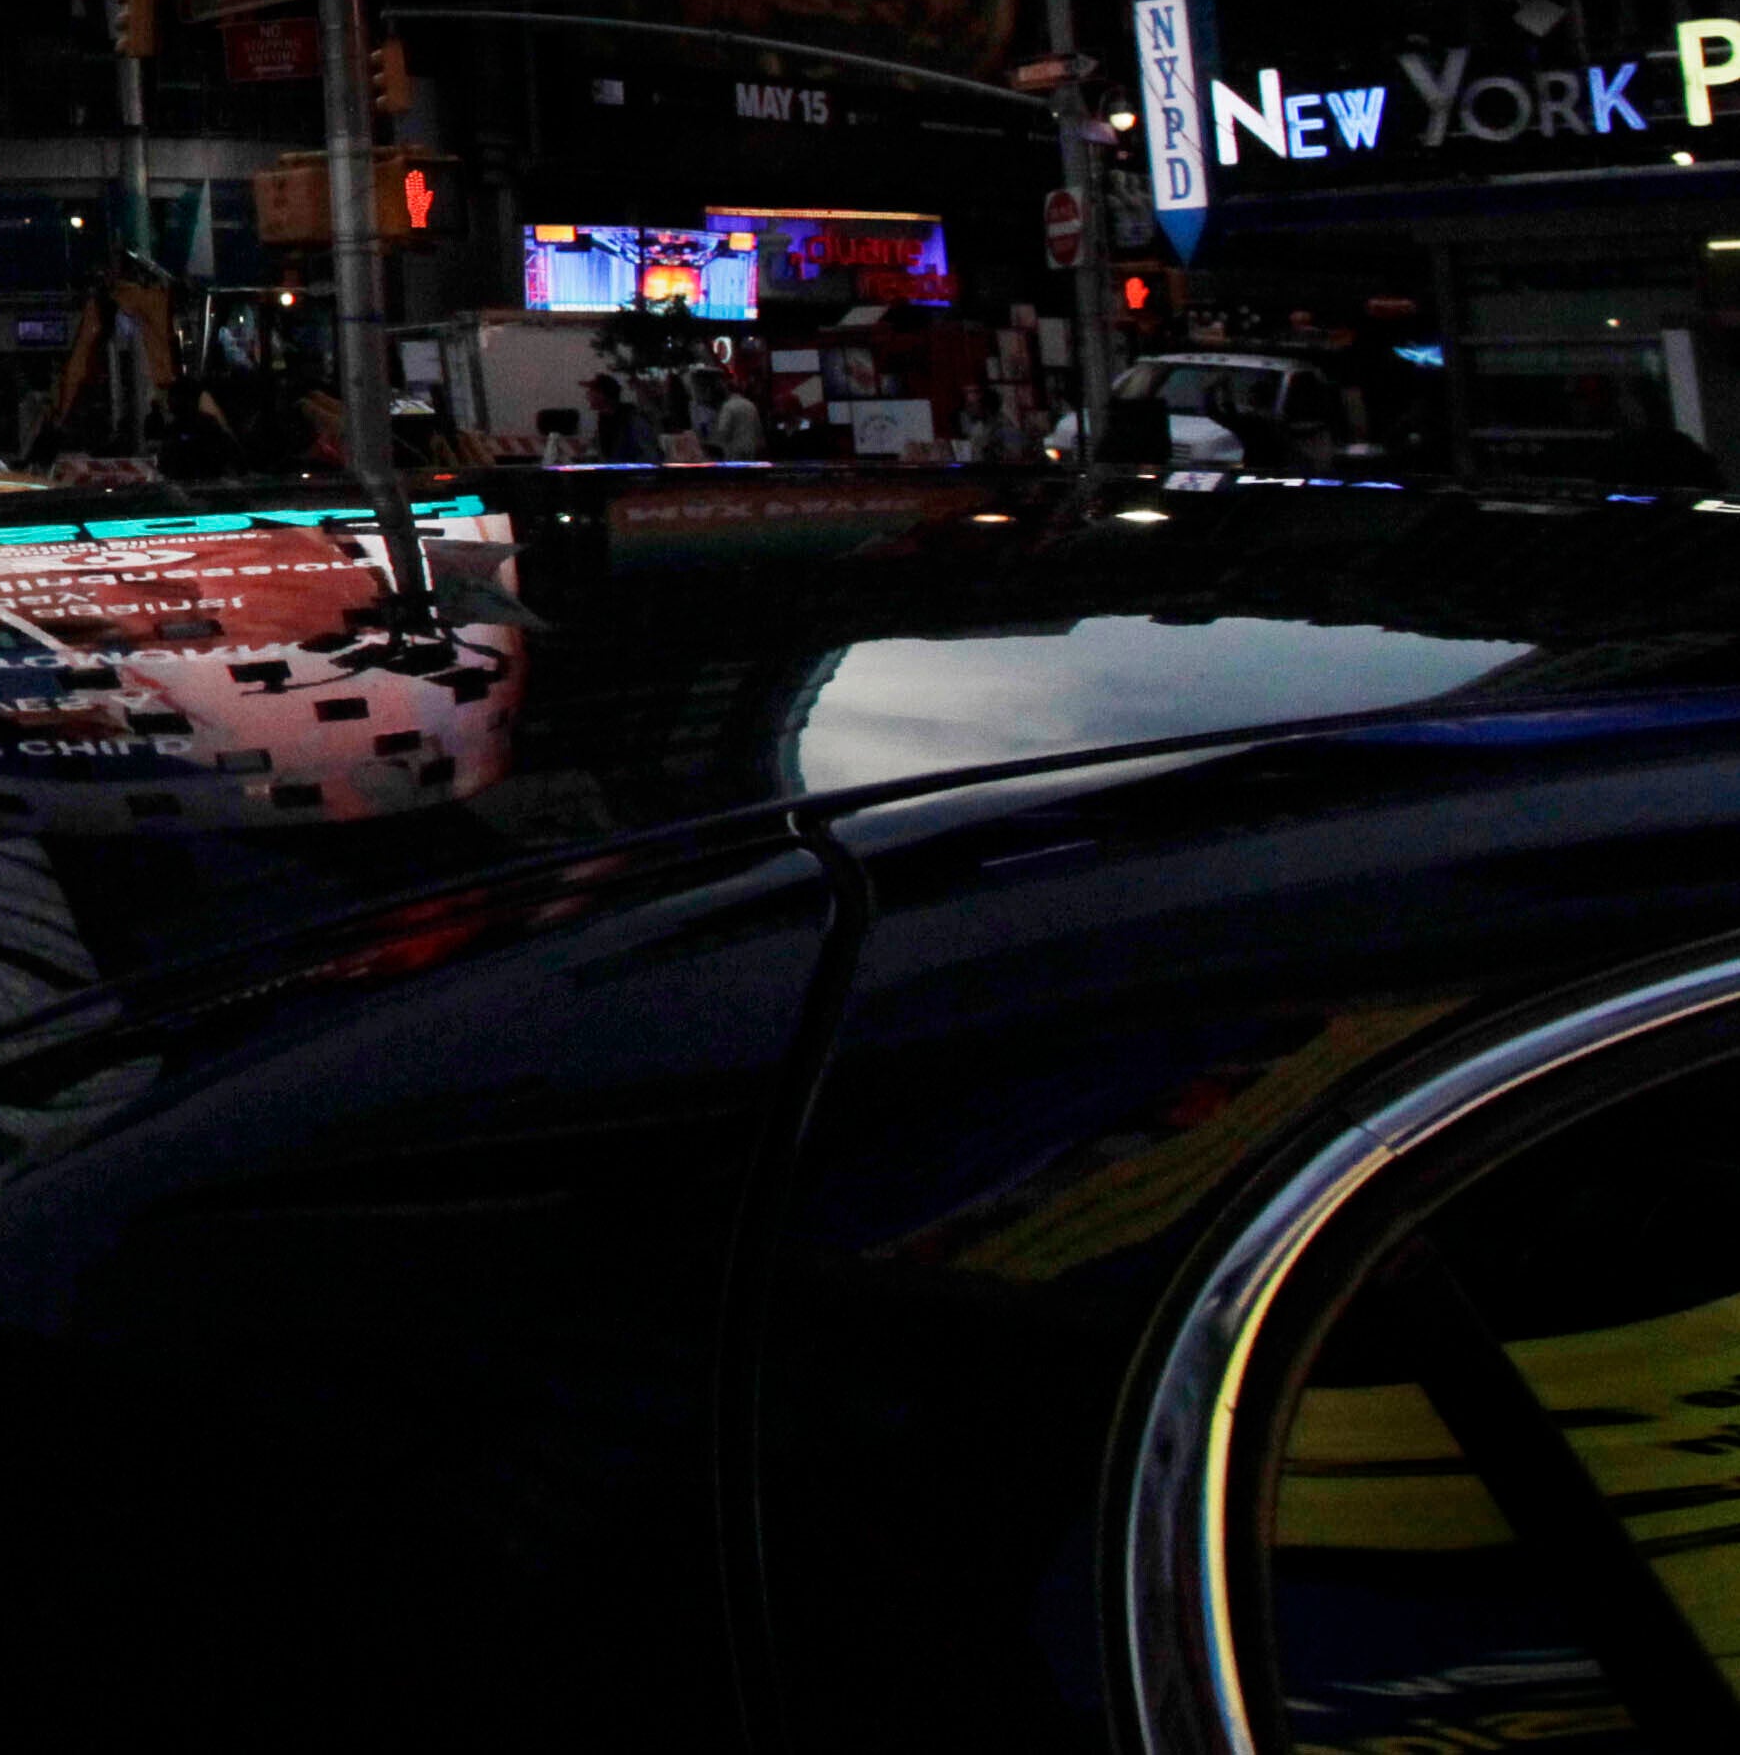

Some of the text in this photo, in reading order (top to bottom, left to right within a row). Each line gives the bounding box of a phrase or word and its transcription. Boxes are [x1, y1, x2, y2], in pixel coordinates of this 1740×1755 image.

[735, 81, 830, 126] MAY 15
[1148, 5, 1193, 203] NYPD
